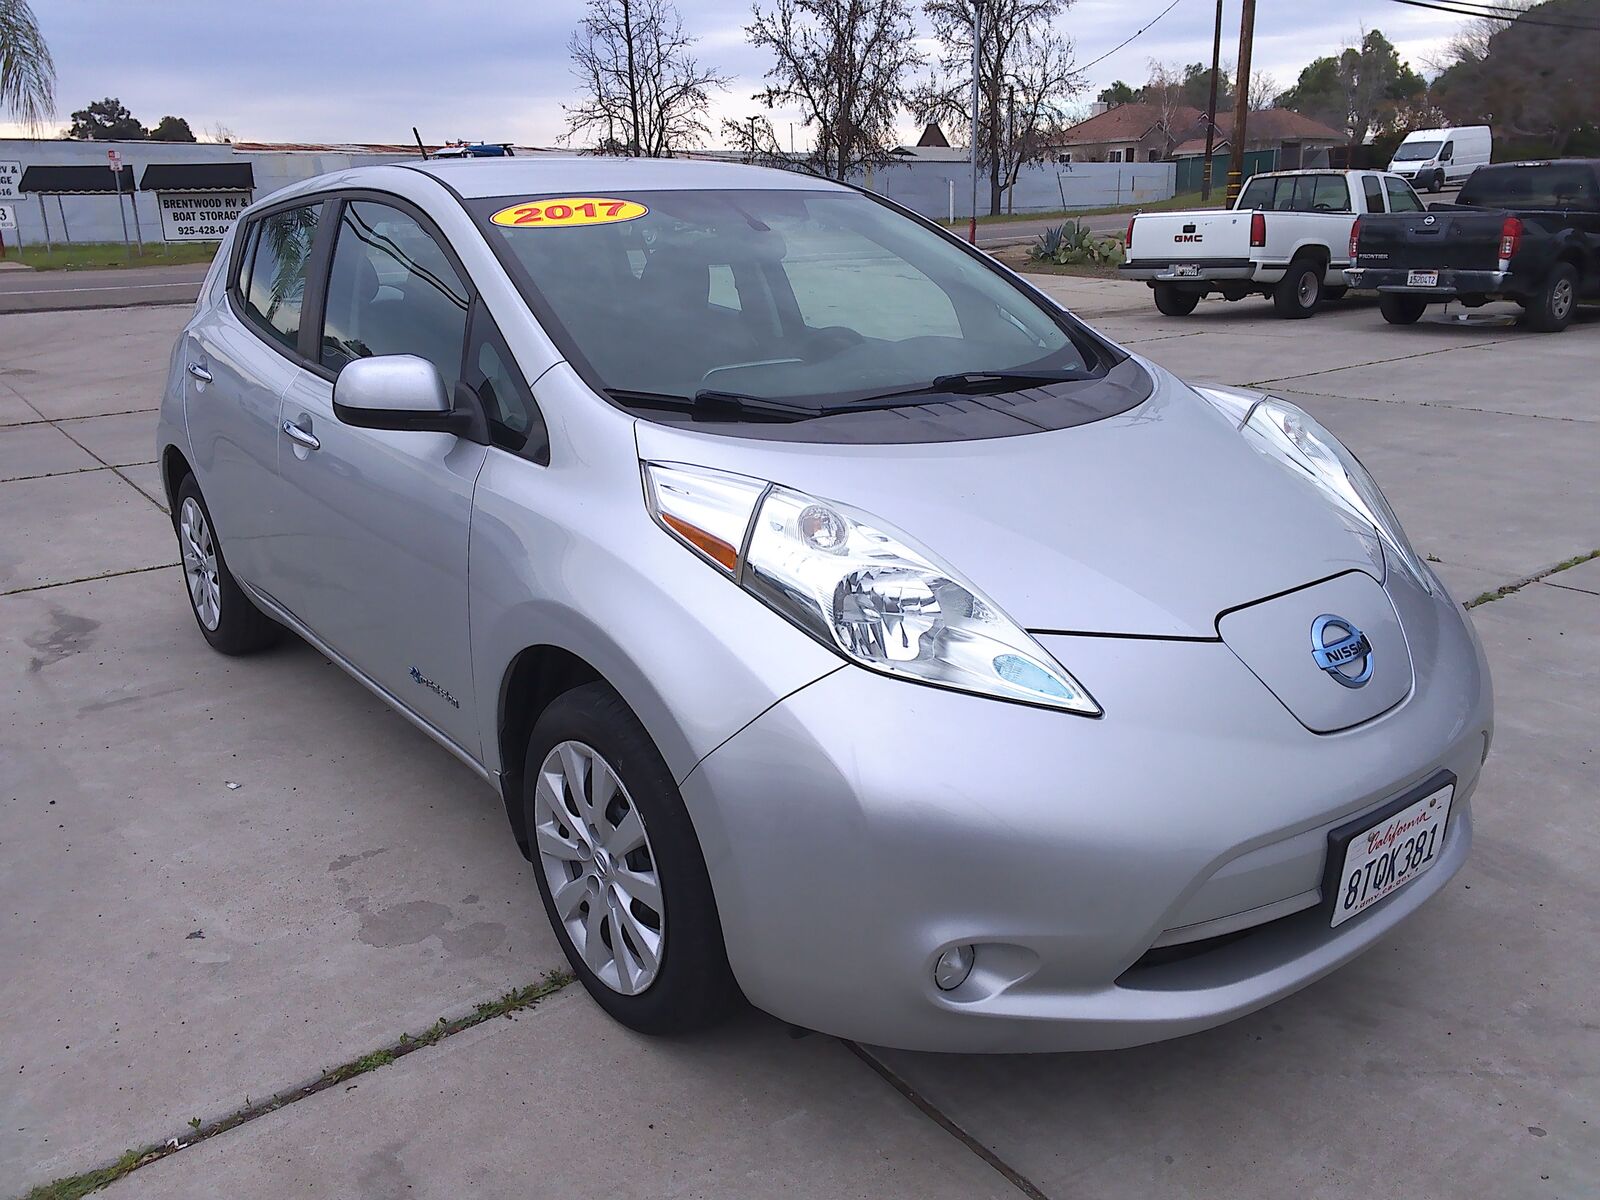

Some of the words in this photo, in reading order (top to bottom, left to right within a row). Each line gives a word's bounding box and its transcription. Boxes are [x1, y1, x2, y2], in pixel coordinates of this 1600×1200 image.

[0, 176, 12, 185] GE
[0, 188, 12, 196] 16
[163, 199, 222, 209] BRENTWOOD
[225, 198, 237, 207] RV
[240, 197, 248, 207] &
[172, 211, 196, 221] BOAT
[513, 202, 627, 224] 2017
[1174, 234, 1203, 243] GMC
[1367, 808, 1432, 855] California
[1343, 822, 1439, 911] 8TQK381
